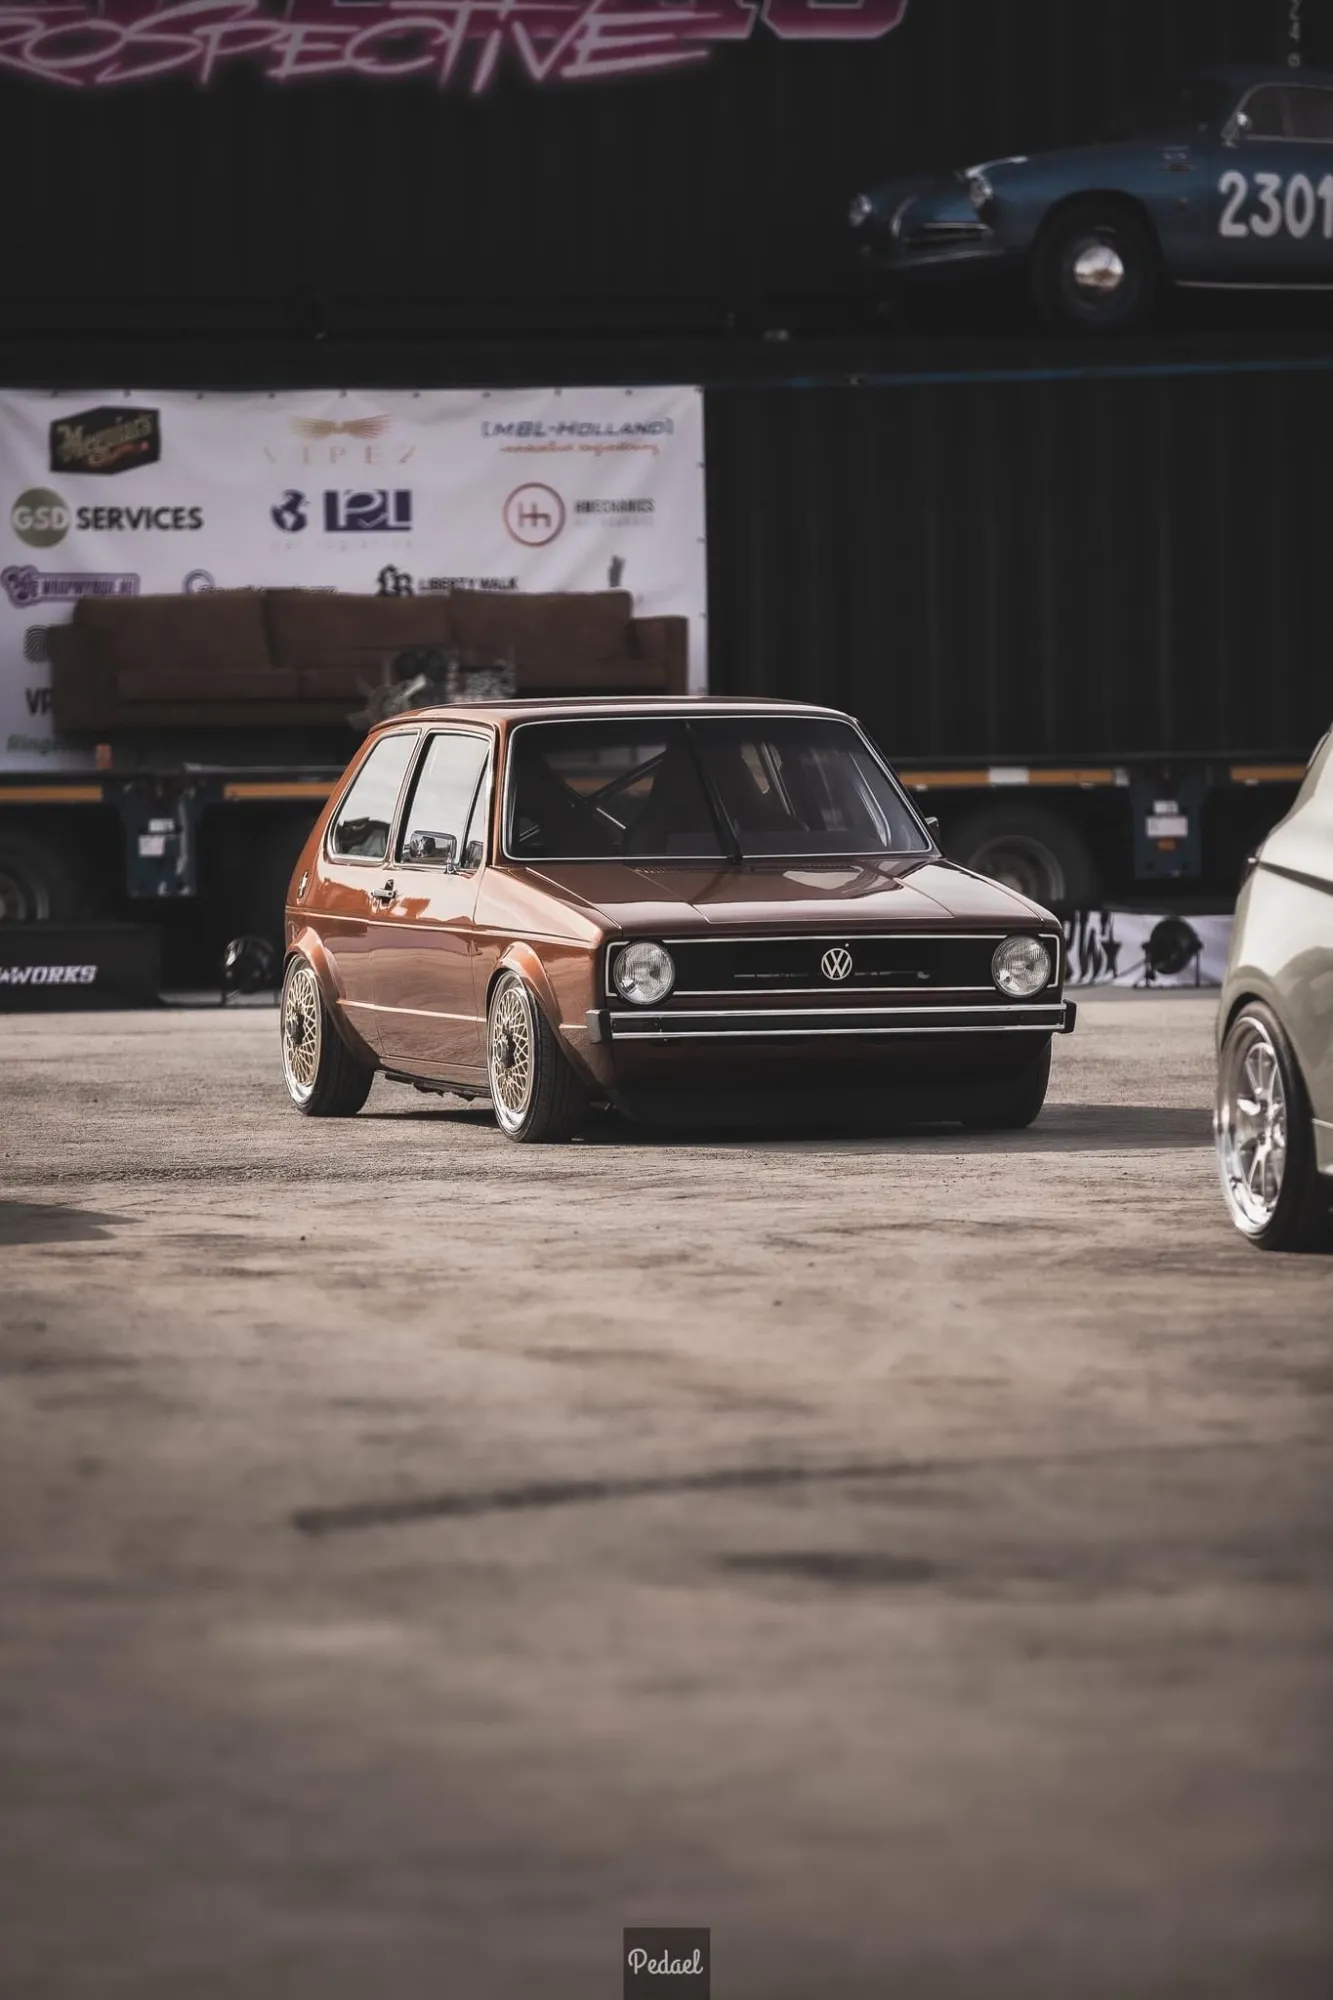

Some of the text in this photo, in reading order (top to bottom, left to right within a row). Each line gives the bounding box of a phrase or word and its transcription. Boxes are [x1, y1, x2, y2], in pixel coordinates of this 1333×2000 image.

[13, 505, 204, 531] GSD SERVICES
[417, 575, 478, 591] LIBERTY
[479, 576, 520, 590] WALK
